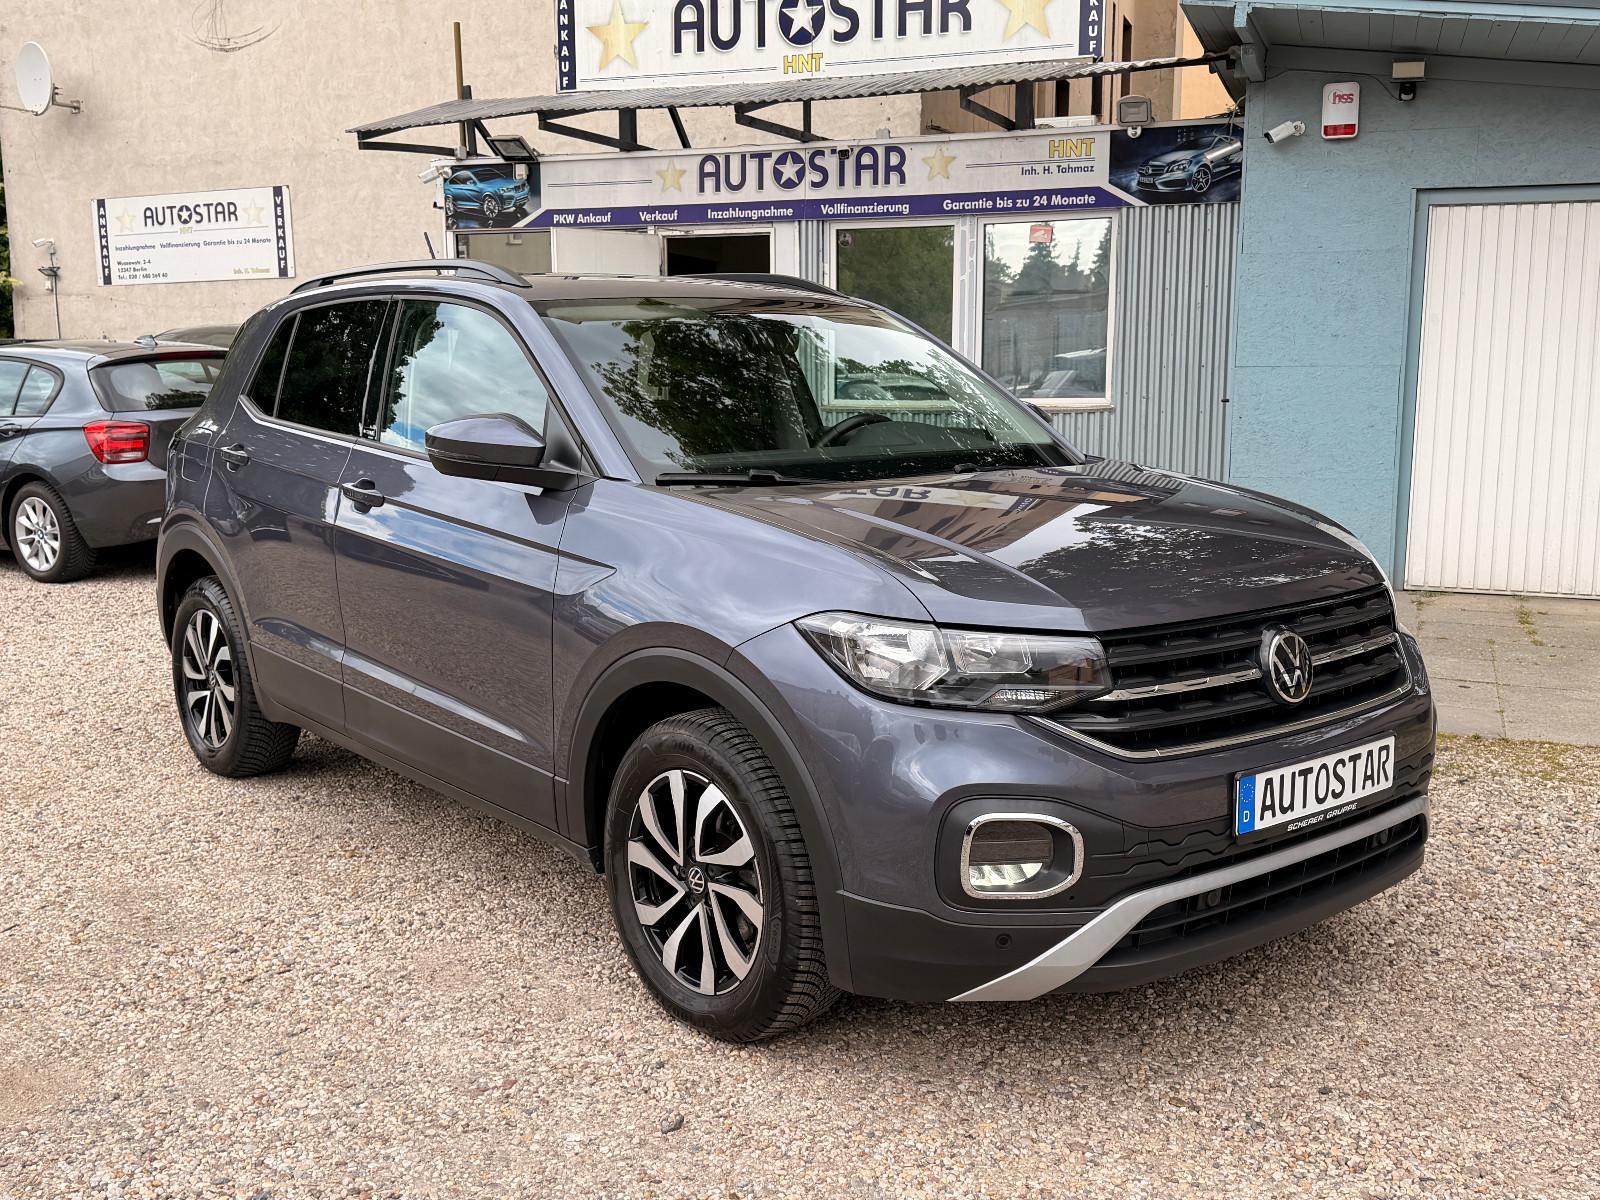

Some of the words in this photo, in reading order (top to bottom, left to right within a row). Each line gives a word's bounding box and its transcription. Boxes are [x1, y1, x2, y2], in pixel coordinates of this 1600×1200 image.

[783, 52, 824, 75] HNT
[1048, 137, 1096, 159] HNT
[698, 146, 907, 193] AUTOSTAR
[1021, 165, 1040, 176] Inh.
[1043, 165, 1053, 175] H.
[1056, 163, 1095, 174] Tahmaz
[144, 202, 238, 226] AUTOSTAR
[553, 214, 575, 224] PKW
[577, 212, 612, 223] Ankauf
[639, 210, 679, 222] Verkauf
[707, 206, 794, 219] Inzahlungnahme
[820, 201, 910, 216] Vollfinanzierung
[943, 197, 993, 211] Garantie
[996, 196, 1014, 209] bis
[1016, 197, 1031, 208] zu
[1033, 195, 1048, 207] 24
[1051, 193, 1096, 206] Monate
[99, 207, 110, 277] ANKAUF
[275, 196, 286, 269] VERKAUF
[1259, 744, 1390, 821] AUTOSTAR
[1243, 810, 1250, 823] D
[1287, 814, 1324, 832] SCHERER
[1326, 802, 1358, 819] GRUPPE
